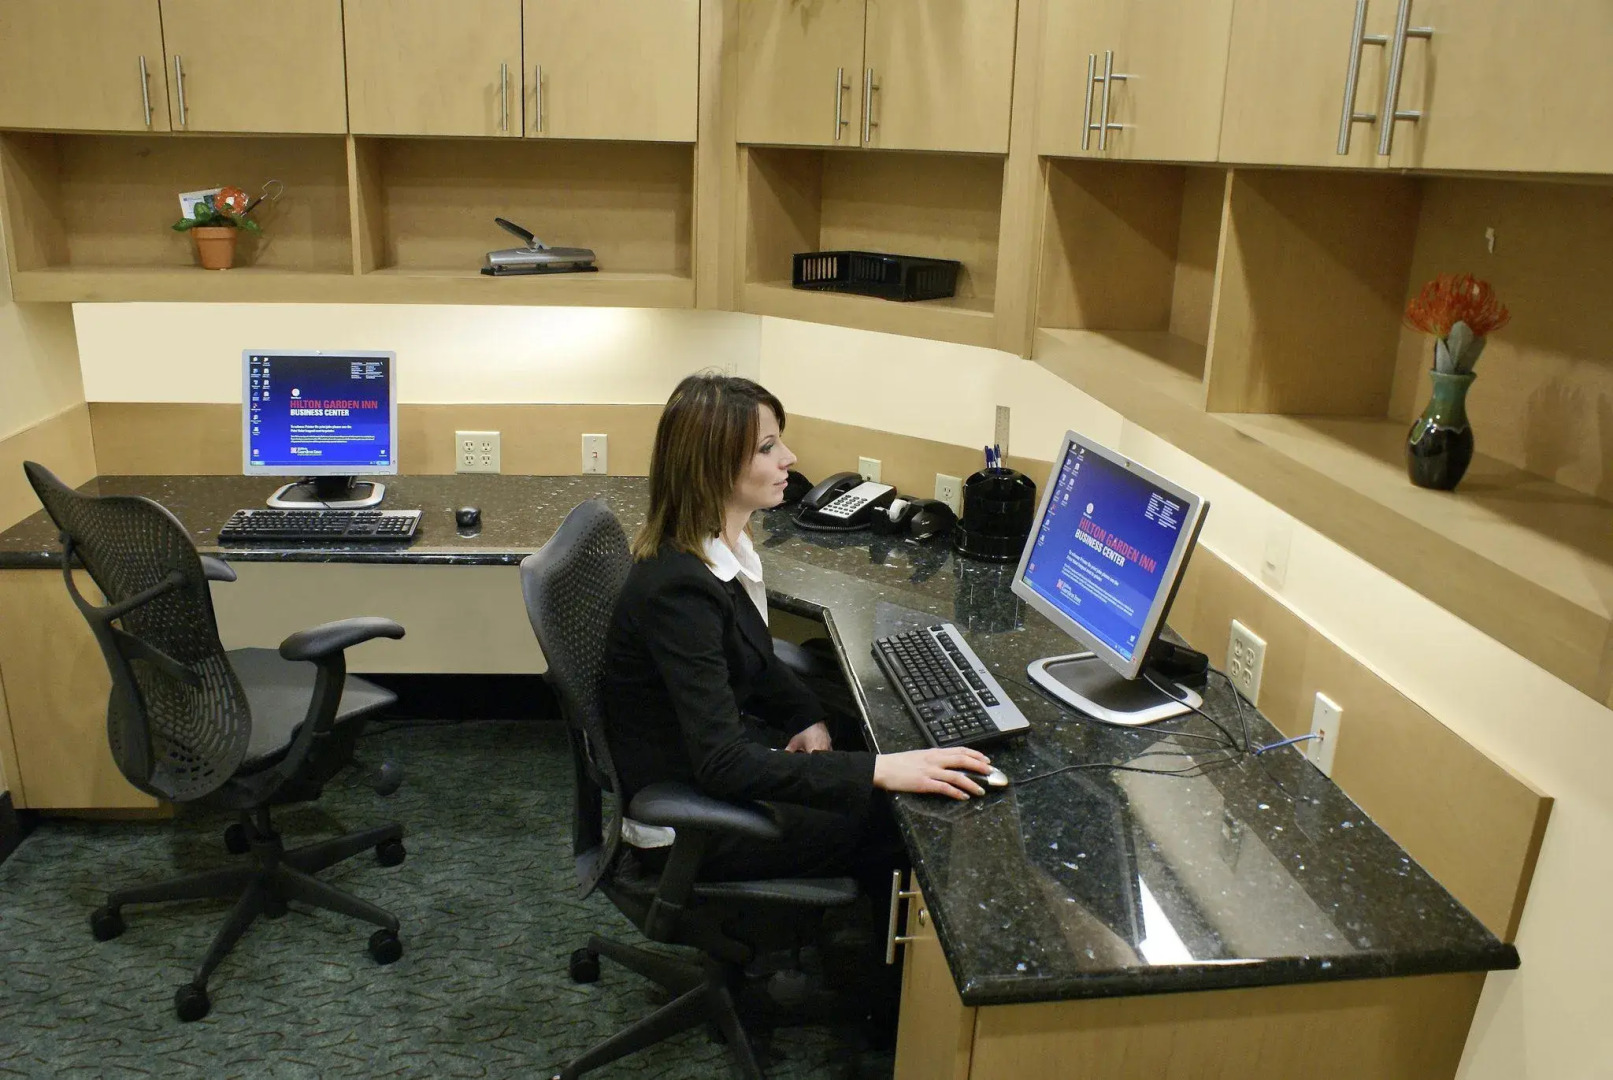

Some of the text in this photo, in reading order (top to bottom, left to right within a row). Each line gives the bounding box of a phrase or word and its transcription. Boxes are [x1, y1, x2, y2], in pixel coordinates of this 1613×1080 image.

[290, 400, 378, 409] HILTON GARDEN INN
[1074, 528, 1103, 552] BUSINESS
[1101, 545, 1125, 567] CENTER
[1078, 516, 1106, 542] HILTON
[1106, 533, 1139, 563] GARDEN
[1138, 553, 1156, 573] INN
